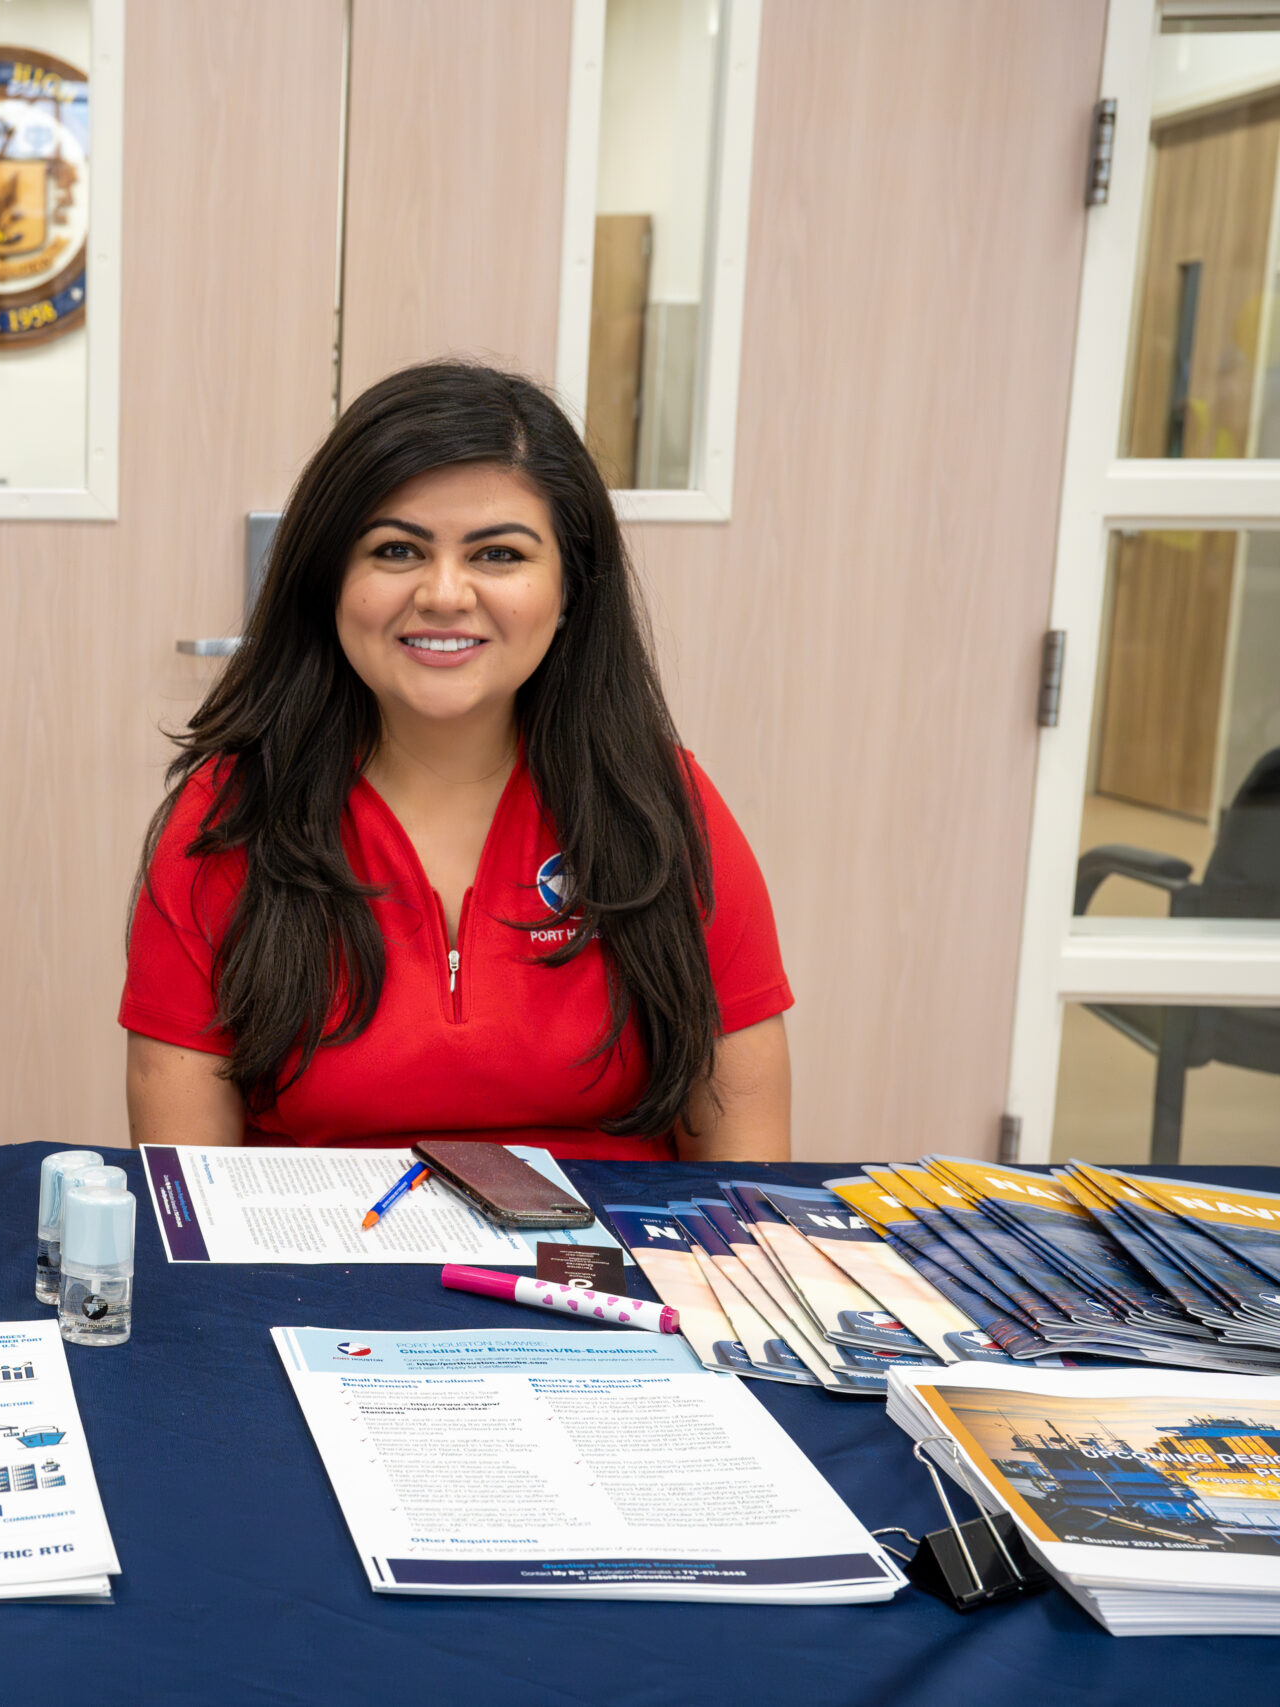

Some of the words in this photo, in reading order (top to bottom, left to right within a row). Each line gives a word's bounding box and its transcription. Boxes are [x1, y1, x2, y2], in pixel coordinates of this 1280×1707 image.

[530, 929, 565, 942] PORT
[854, 1323, 877, 1331] PORT
[879, 1357, 923, 1366] HOUSTON
[1081, 1449, 1214, 1464] UPCOMING
[1186, 1474, 1249, 1486] (Project
[2, 1509, 76, 1523] COMMITMENTS
[449, 1537, 539, 1545] Requirements
[1082, 1537, 1128, 1547] Quarter
[1133, 1540, 1161, 1548] 2024
[1164, 1541, 1210, 1550] Edition
[39, 1543, 75, 1556] RTG
